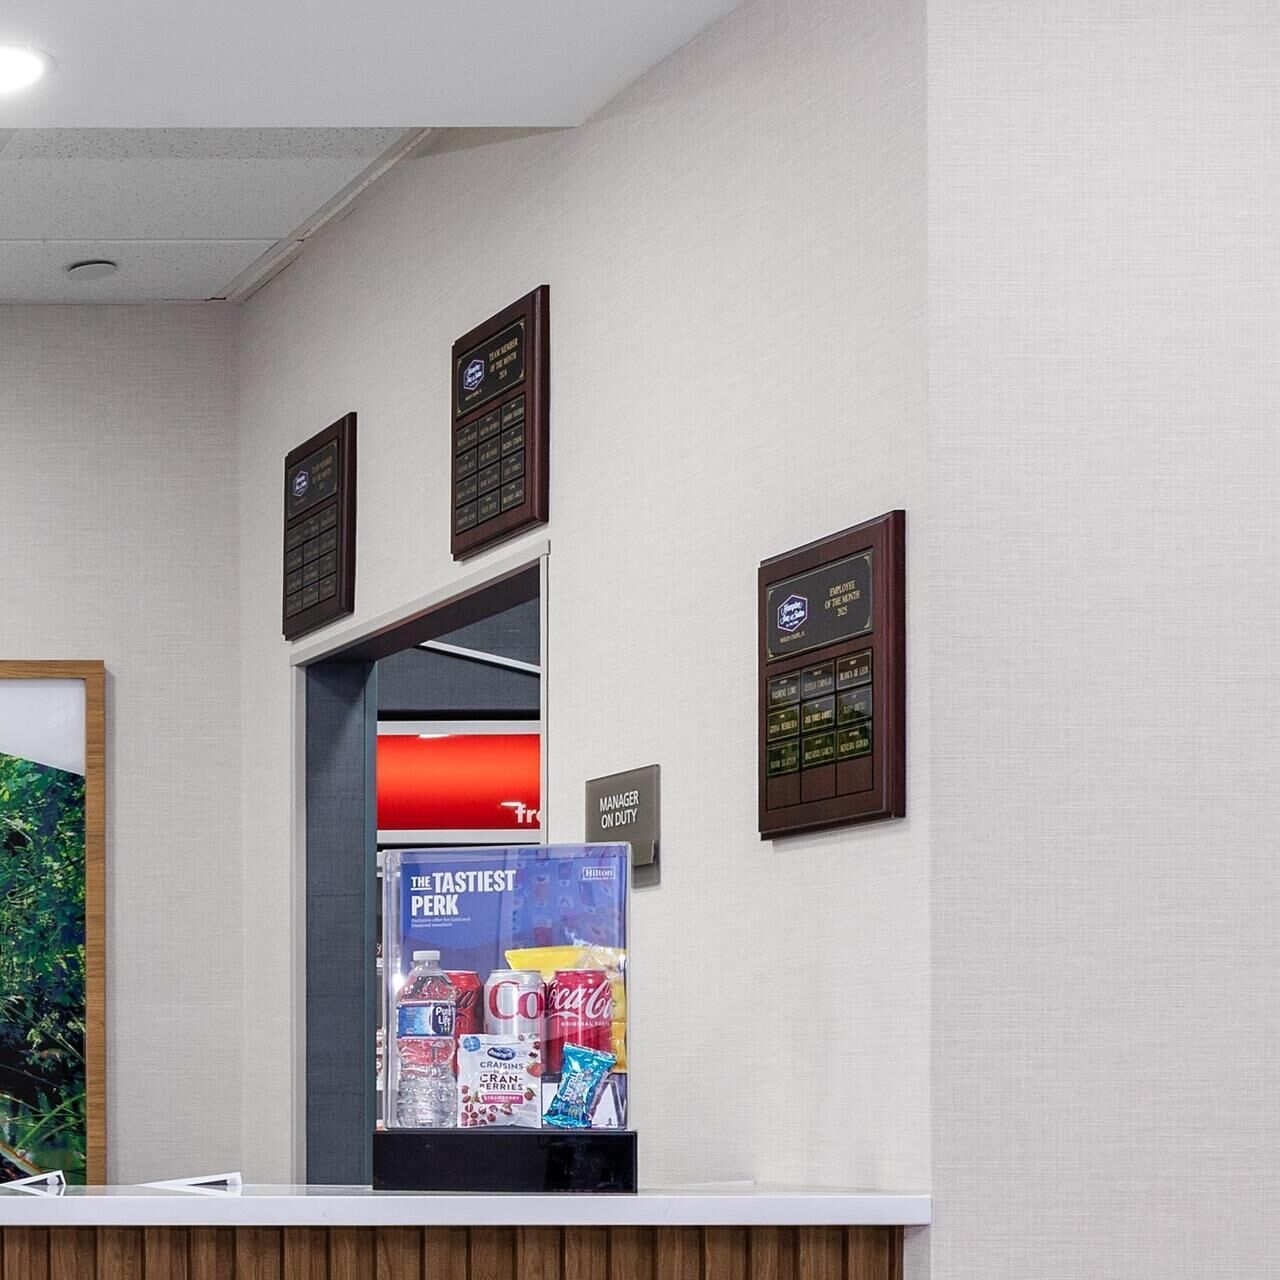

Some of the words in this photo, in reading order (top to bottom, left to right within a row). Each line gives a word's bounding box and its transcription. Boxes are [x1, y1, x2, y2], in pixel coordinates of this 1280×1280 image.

[599, 790, 639, 813] MANAGER
[601, 814, 613, 829] ON
[615, 809, 637, 827] DUTY
[411, 876, 431, 888] THE
[432, 870, 516, 893] TASTIEST
[585, 868, 614, 878] Hilton
[411, 895, 459, 917] PERK
[480, 1061, 524, 1070] CRAISINS
[480, 1074, 524, 1084] CRAN-
